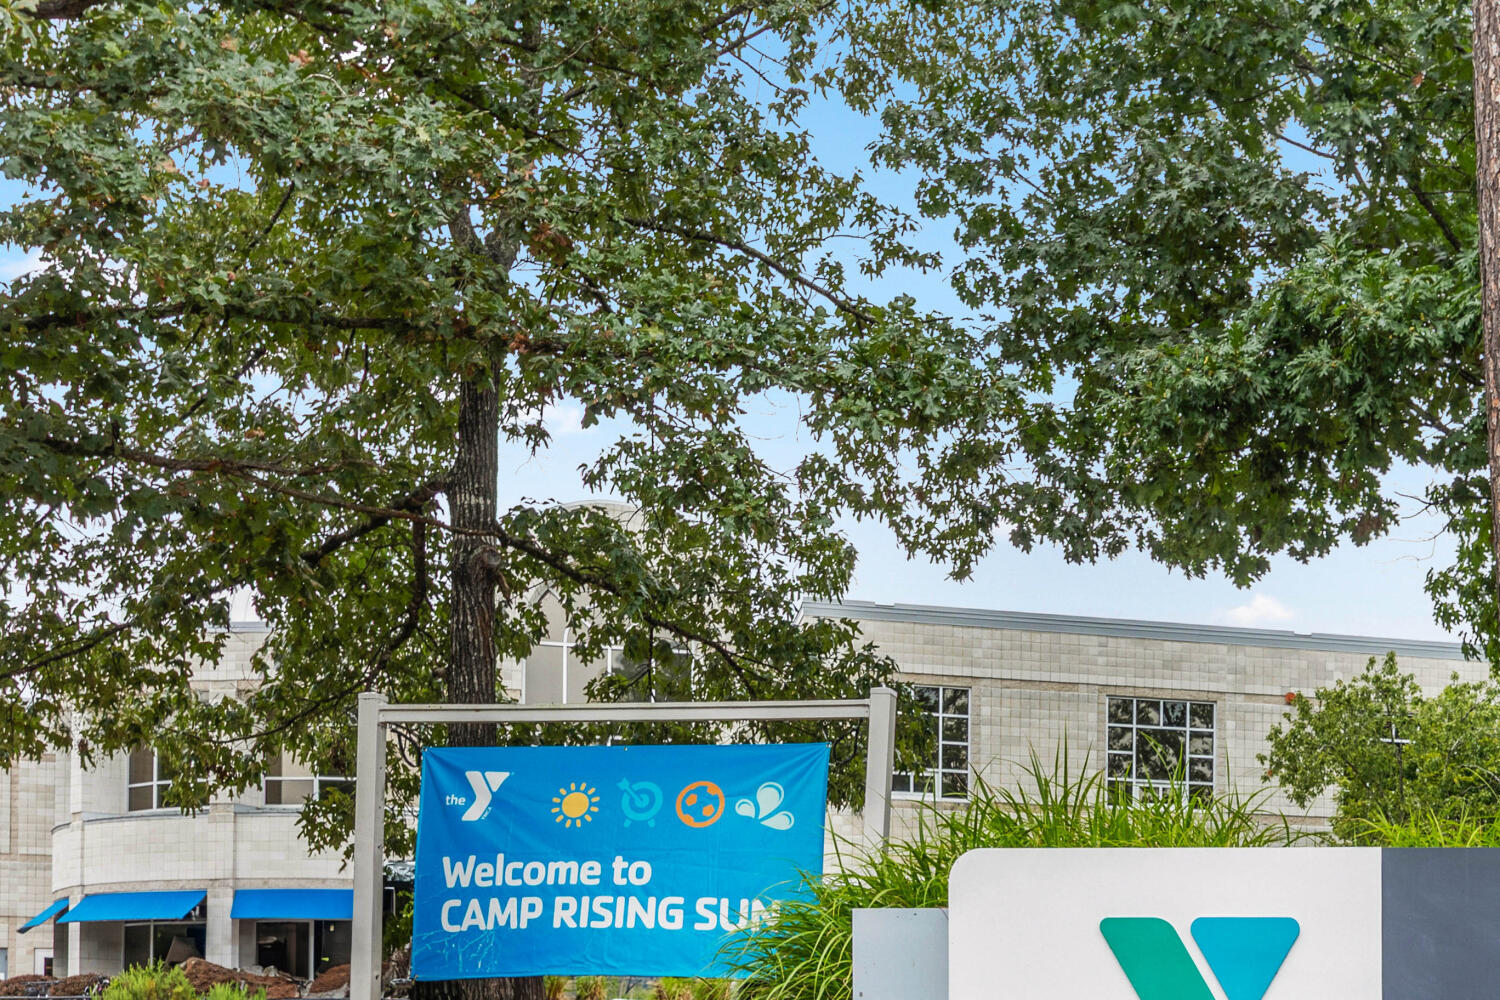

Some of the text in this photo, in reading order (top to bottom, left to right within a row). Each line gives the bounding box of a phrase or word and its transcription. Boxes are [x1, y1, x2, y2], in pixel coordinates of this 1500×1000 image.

[445, 793, 466, 806] the
[442, 853, 652, 888] Welcome to
[441, 897, 543, 932] CAMP
[552, 895, 684, 931] RISING
